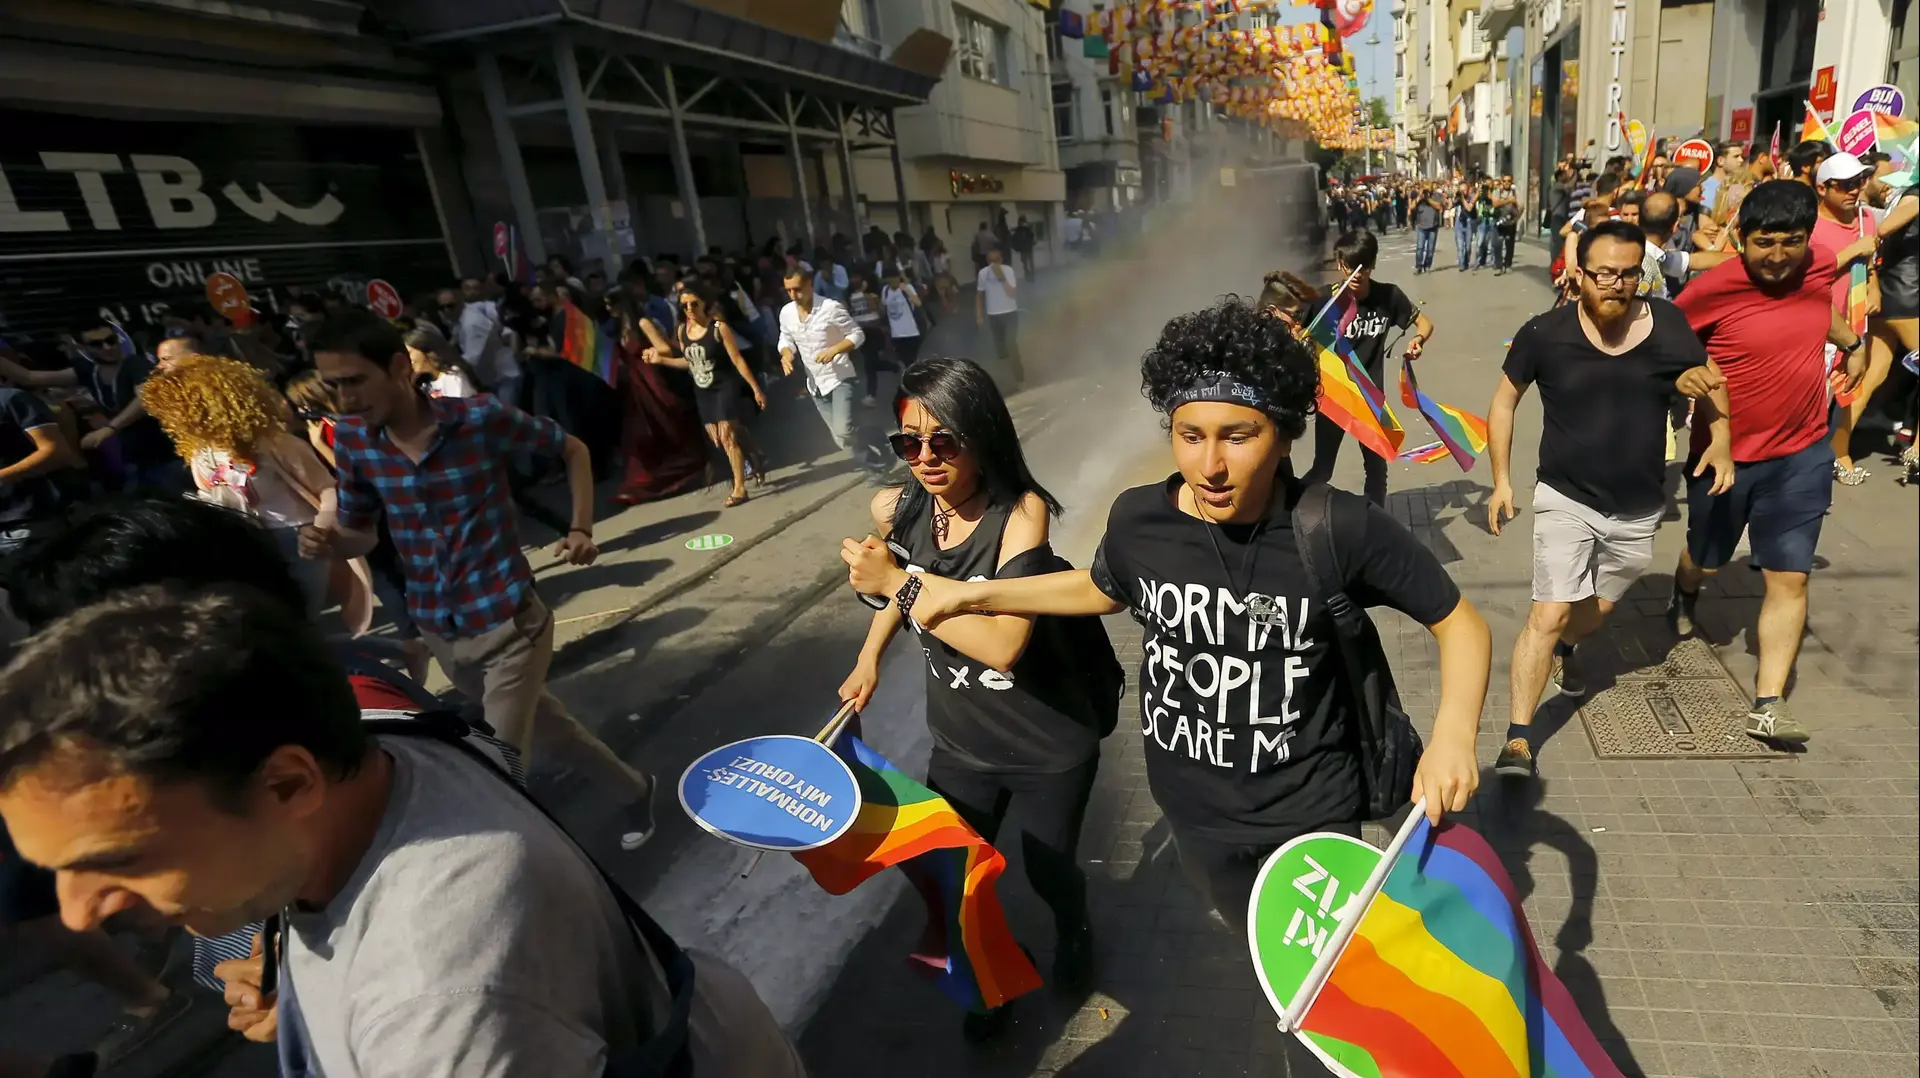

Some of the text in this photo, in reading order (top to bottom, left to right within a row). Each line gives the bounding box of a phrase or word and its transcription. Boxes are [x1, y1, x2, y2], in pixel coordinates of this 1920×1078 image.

[1680, 147, 1709, 159] YASAK
[1138, 577, 1314, 652] NORMAL
[1145, 633, 1310, 725] PEOPLE
[1142, 691, 1235, 768] SCARE
